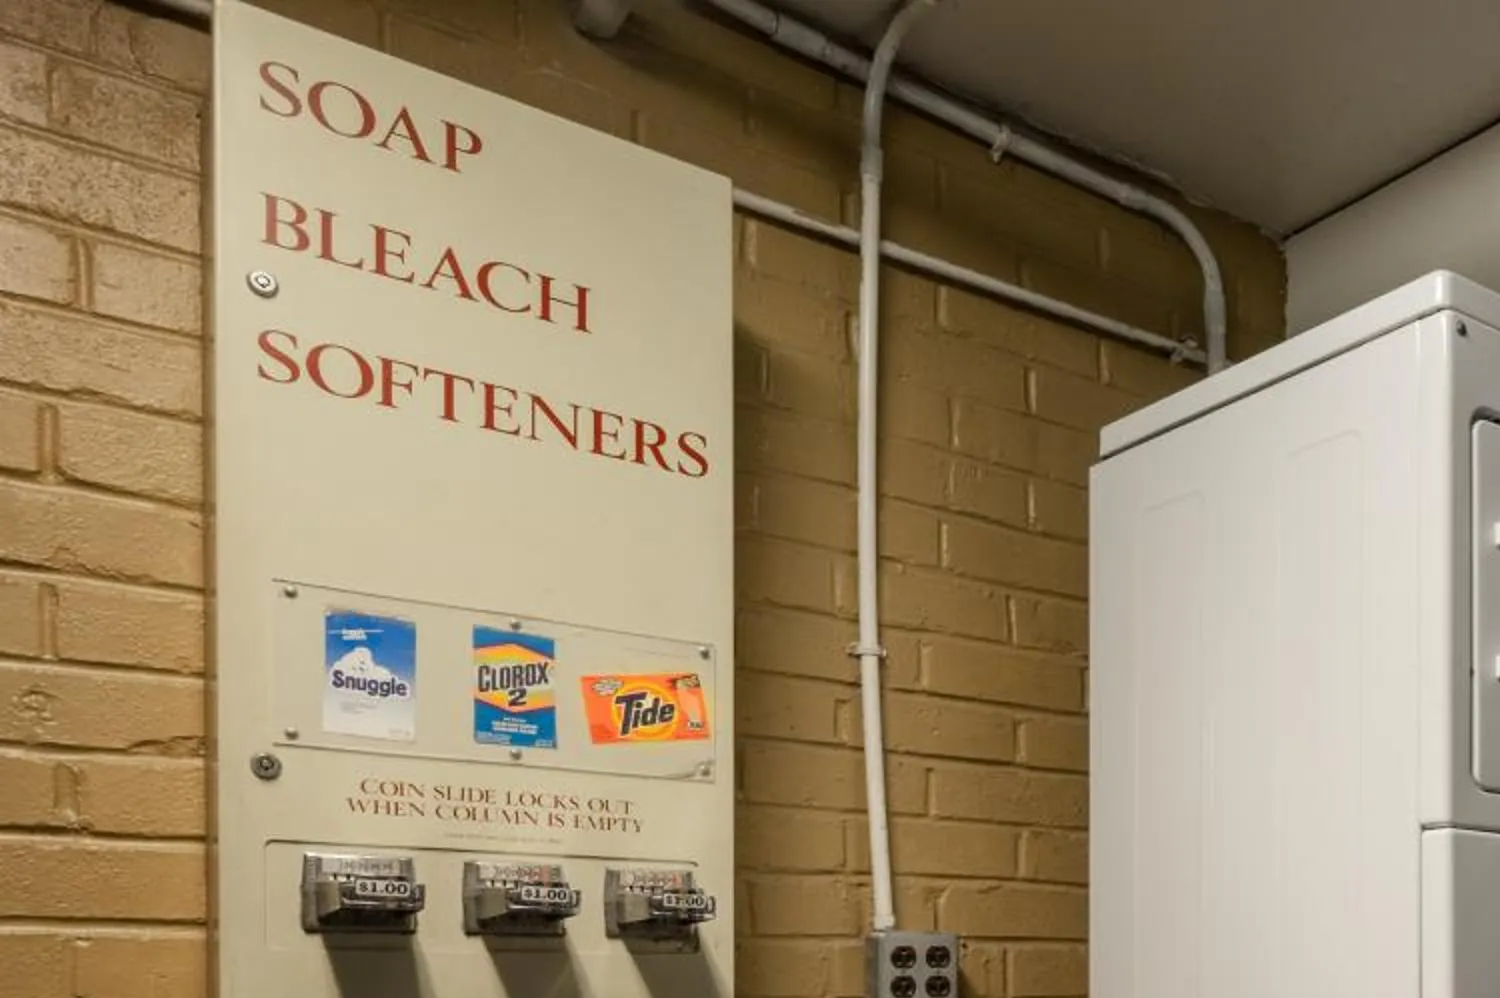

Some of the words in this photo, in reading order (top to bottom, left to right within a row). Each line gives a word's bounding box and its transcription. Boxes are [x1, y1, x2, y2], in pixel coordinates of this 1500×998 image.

[258, 60, 483, 173] SOAP
[259, 191, 593, 334] BLEACH
[257, 328, 710, 479] SOFTENERS
[331, 669, 408, 697] Snuggle
[477, 661, 550, 693] CLOROX
[507, 688, 528, 707] 2
[614, 691, 675, 736] Tide
[346, 797, 426, 818] WHEN
[435, 805, 539, 827] COLUMN
[547, 812, 566, 829] IS
[573, 814, 645, 834] EMPTY
[359, 778, 426, 798] COIN
[432, 785, 497, 806] SLIDE
[505, 790, 580, 811] LOCKS
[586, 798, 635, 816] OUT
[357, 881, 409, 896] $1.00
[523, 888, 567, 902] $1.00
